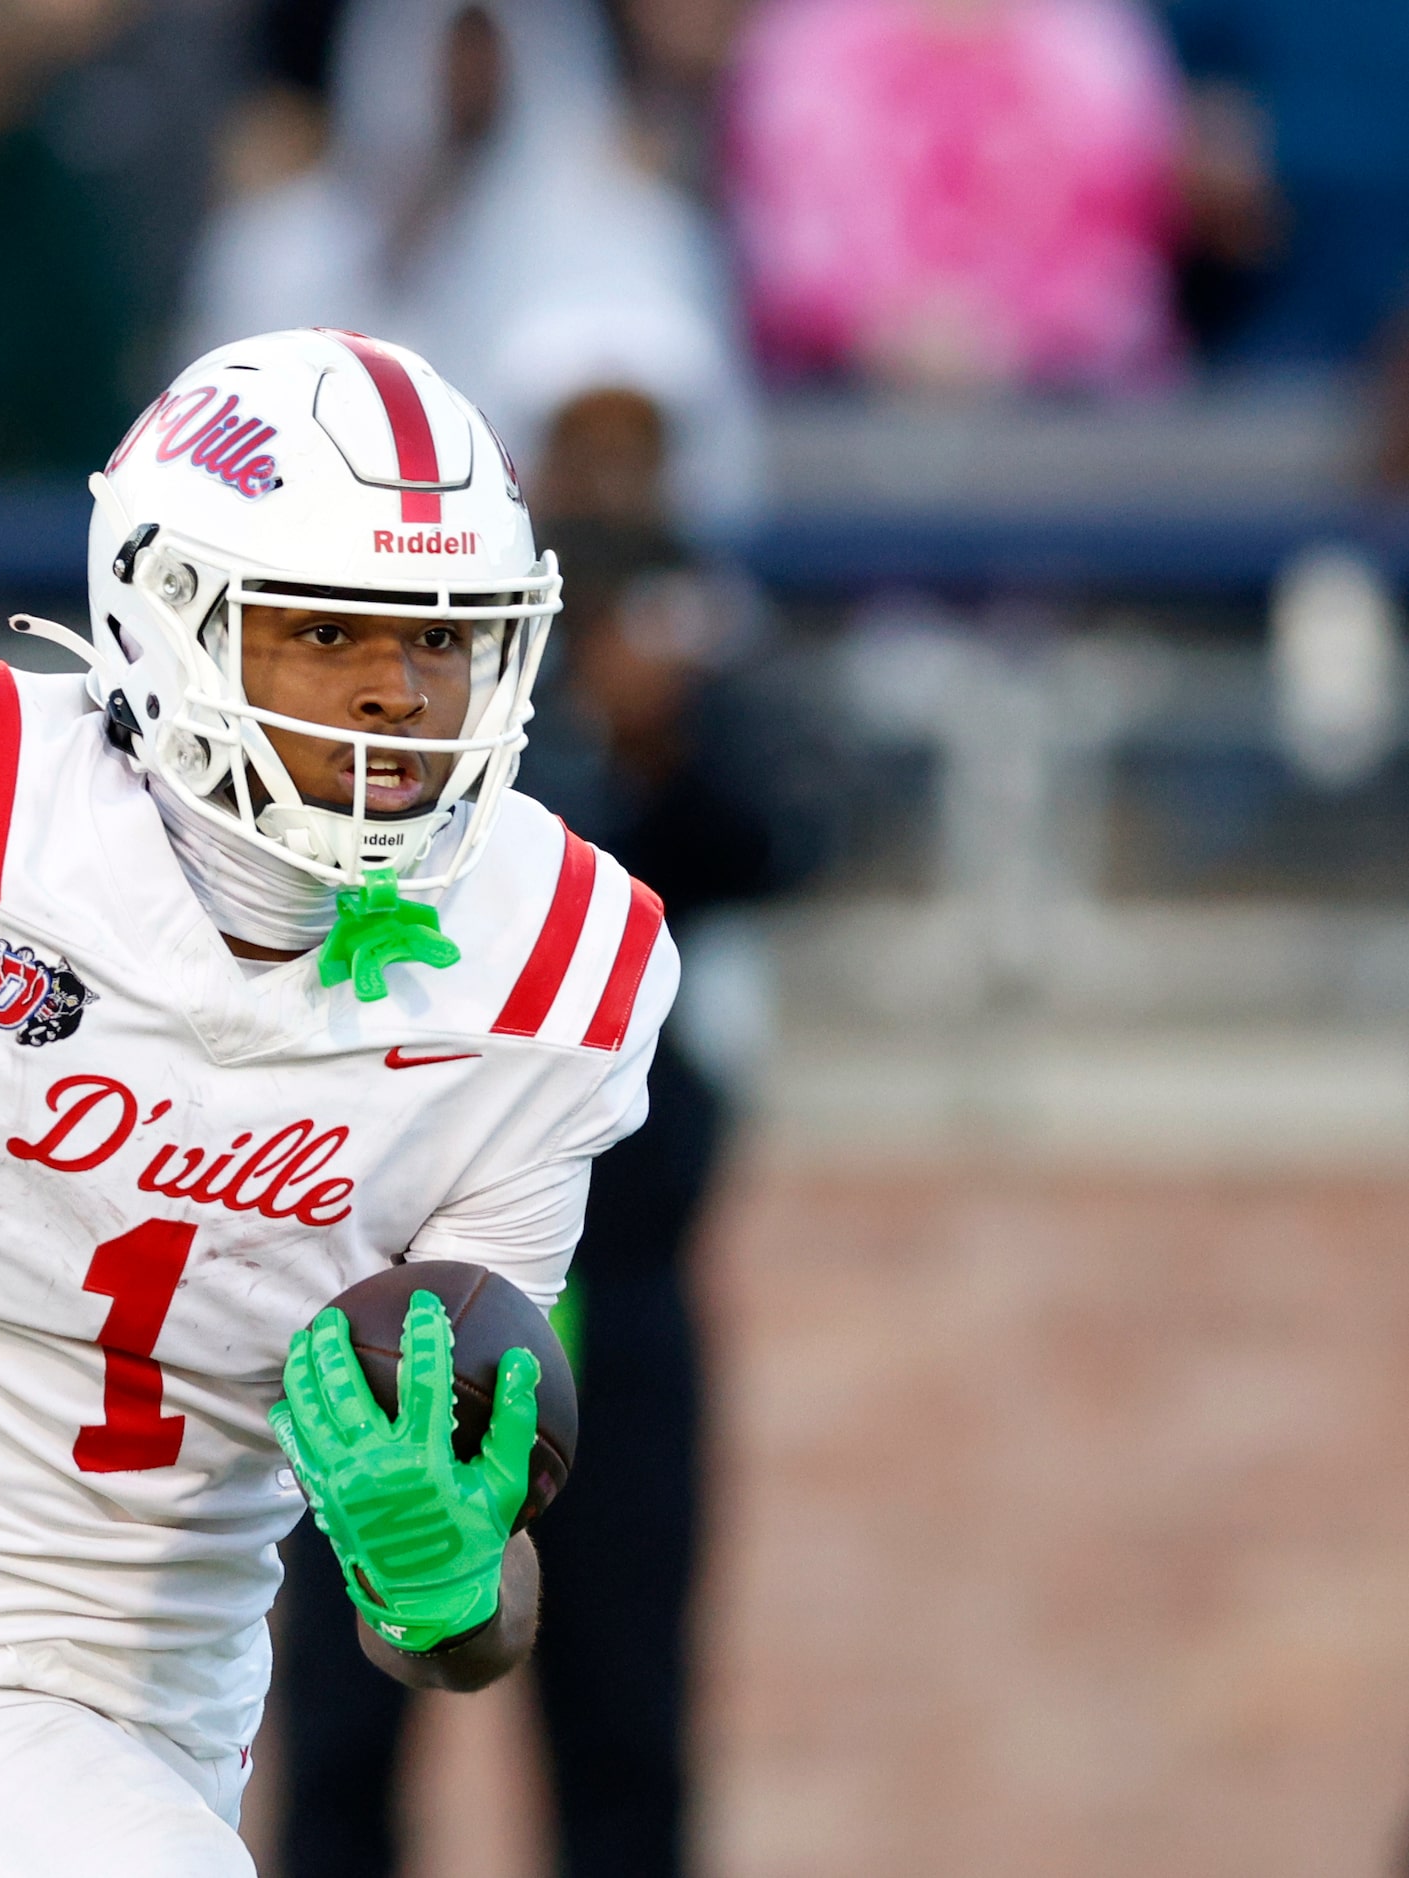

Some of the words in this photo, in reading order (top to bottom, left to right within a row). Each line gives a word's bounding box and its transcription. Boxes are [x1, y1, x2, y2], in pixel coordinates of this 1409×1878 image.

[373, 530, 476, 555] Riddell
[361, 833, 404, 847] iddell
[6, 1074, 354, 1227] D'ville
[72, 1217, 199, 1472] 1
